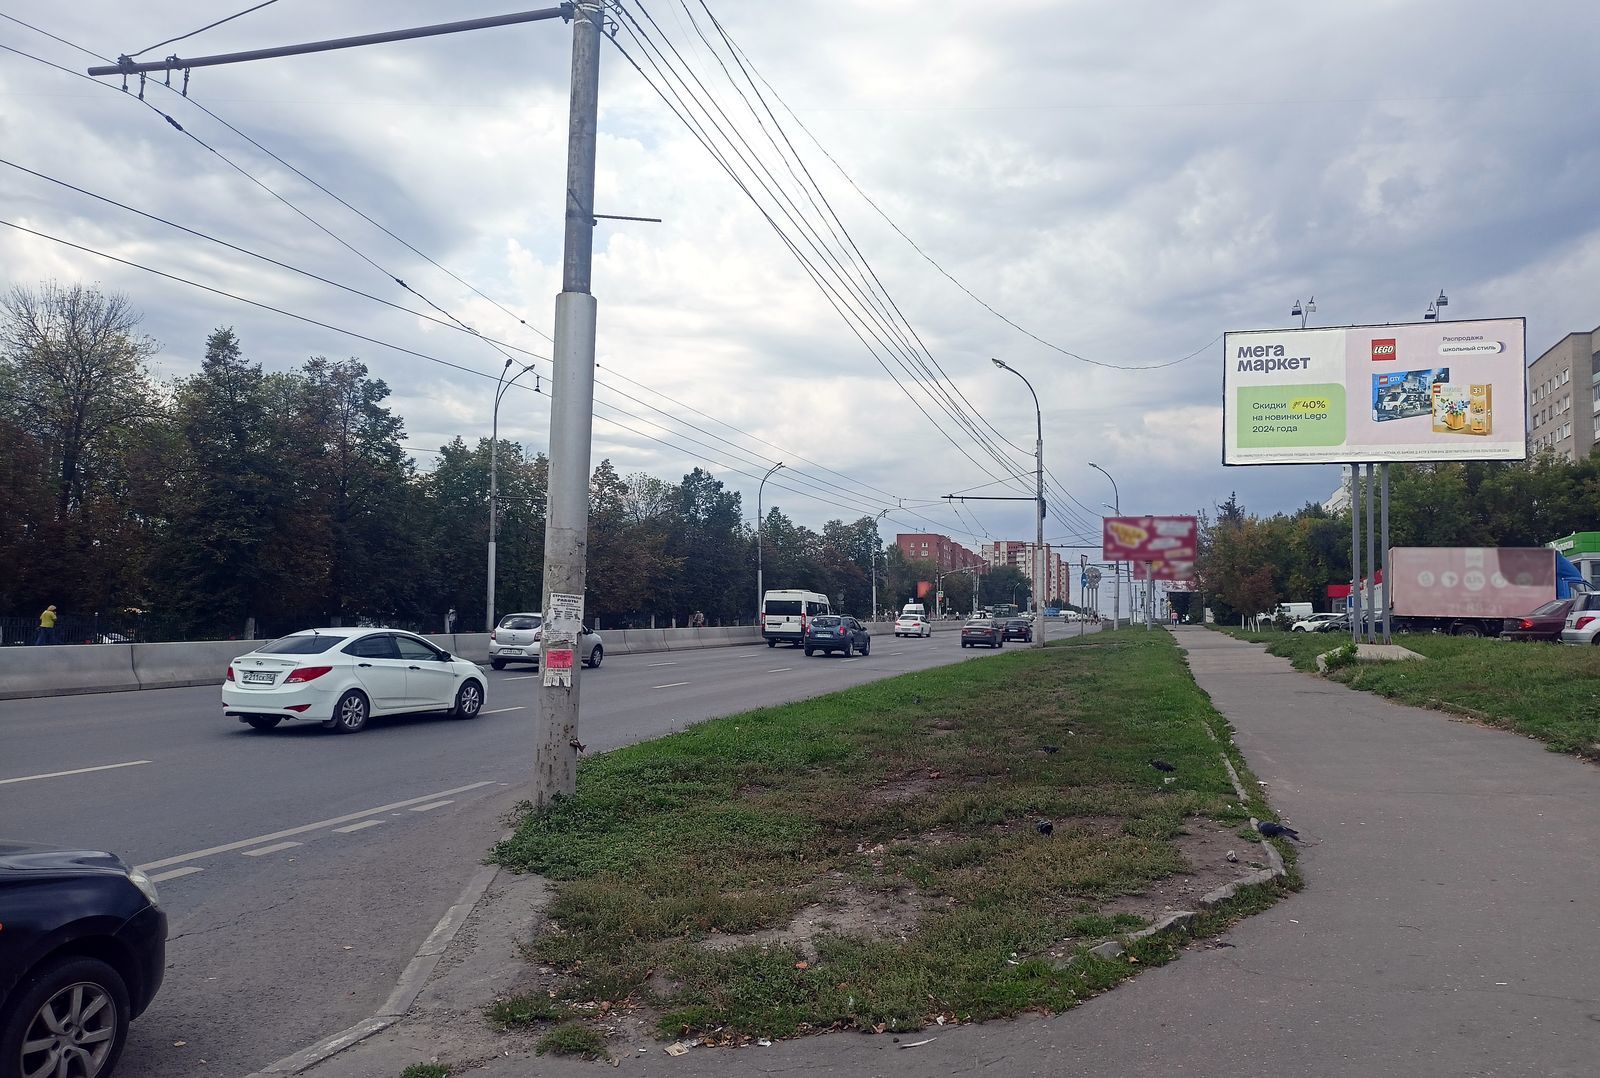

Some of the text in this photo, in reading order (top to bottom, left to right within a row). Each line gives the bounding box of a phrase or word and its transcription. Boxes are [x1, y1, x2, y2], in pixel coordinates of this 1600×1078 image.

[1238, 344, 1284, 358] мега
[1374, 345, 1394, 354] LEGO
[1238, 357, 1310, 373] маркет
[1252, 402, 1286, 410] Скидки
[1302, 400, 1326, 408] 40%
[1305, 413, 1327, 422] Lego
